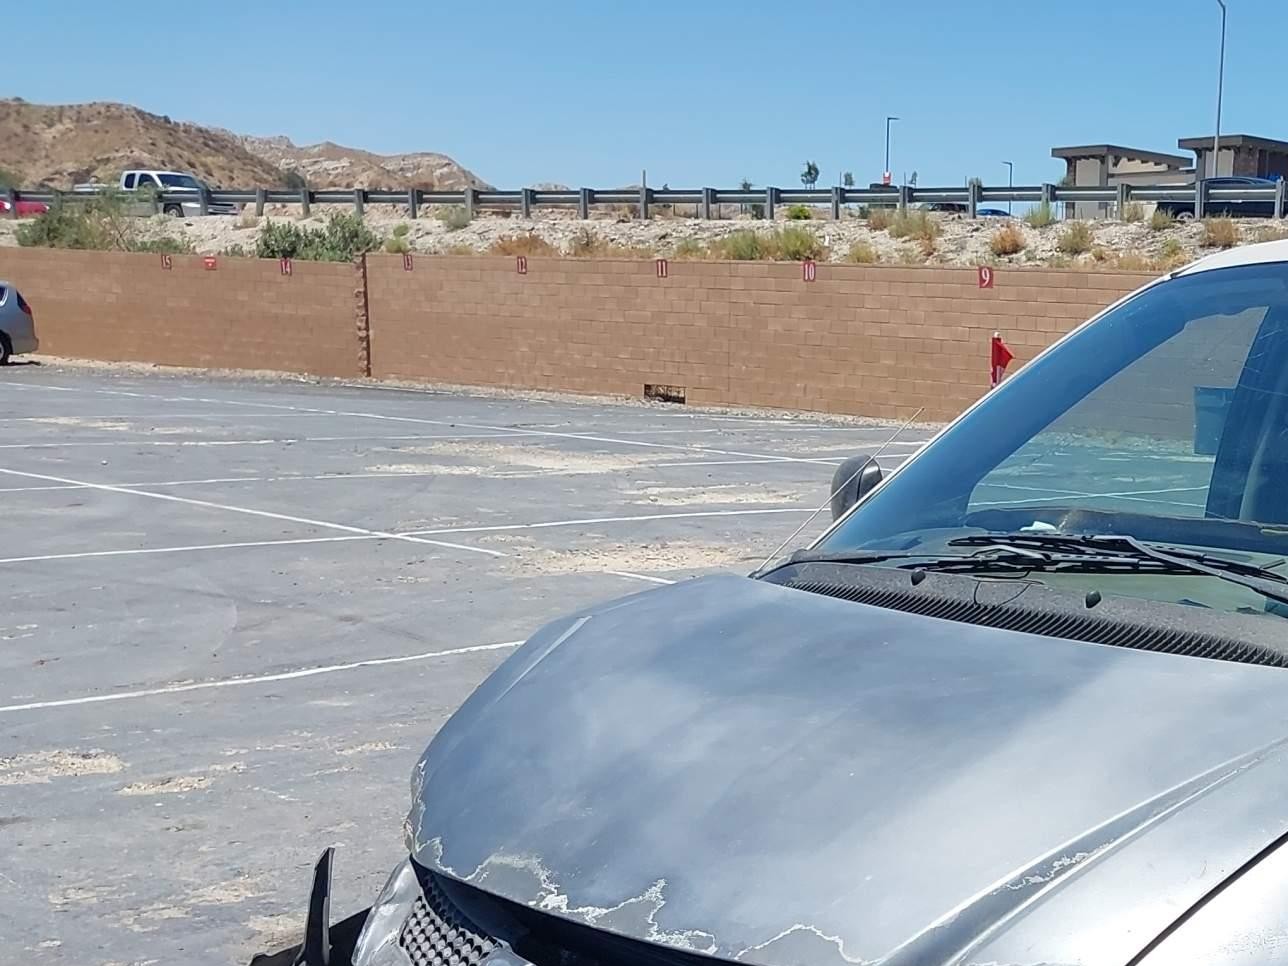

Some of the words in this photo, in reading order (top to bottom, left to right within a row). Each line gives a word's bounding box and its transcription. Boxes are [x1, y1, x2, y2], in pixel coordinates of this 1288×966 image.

[658, 260, 666, 277] 11
[804, 263, 815, 281] 10
[981, 267, 990, 287] 9
